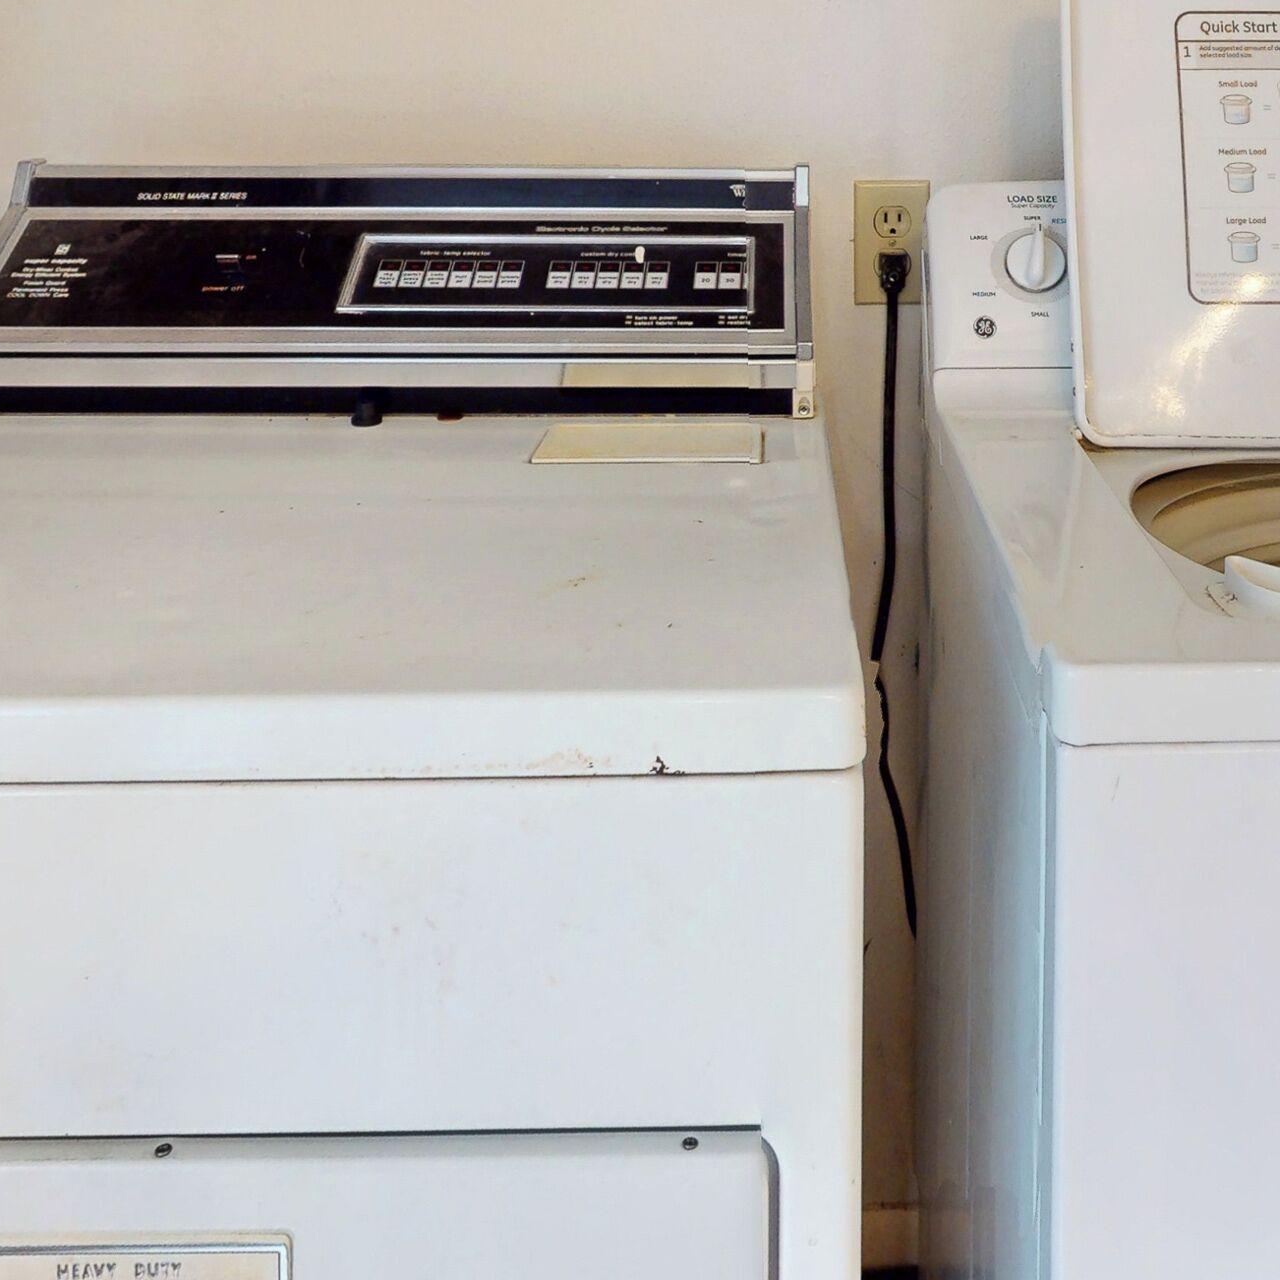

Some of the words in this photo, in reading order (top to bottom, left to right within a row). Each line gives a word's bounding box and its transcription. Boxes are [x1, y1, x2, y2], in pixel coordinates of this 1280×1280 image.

[1200, 20, 1240, 35] Quick
[1243, 20, 1278, 34] Start
[1183, 46, 1192, 59] 1
[1218, 80, 1239, 88] Small
[1240, 80, 1258, 88] Load
[1218, 148, 1247, 156] Medium
[1248, 148, 1267, 156] Load
[137, 192, 161, 200] SOLID
[162, 192, 187, 200] STATE
[187, 192, 210, 200] MARK
[219, 192, 248, 200] SERIES
[1007, 195, 1035, 204] LOAD
[1036, 195, 1059, 204] SIZE
[1226, 217, 1247, 225] Large
[1248, 217, 1267, 225] Load
[57, 1263, 117, 1280] HEAVY
[133, 1262, 182, 1279] DUTY
